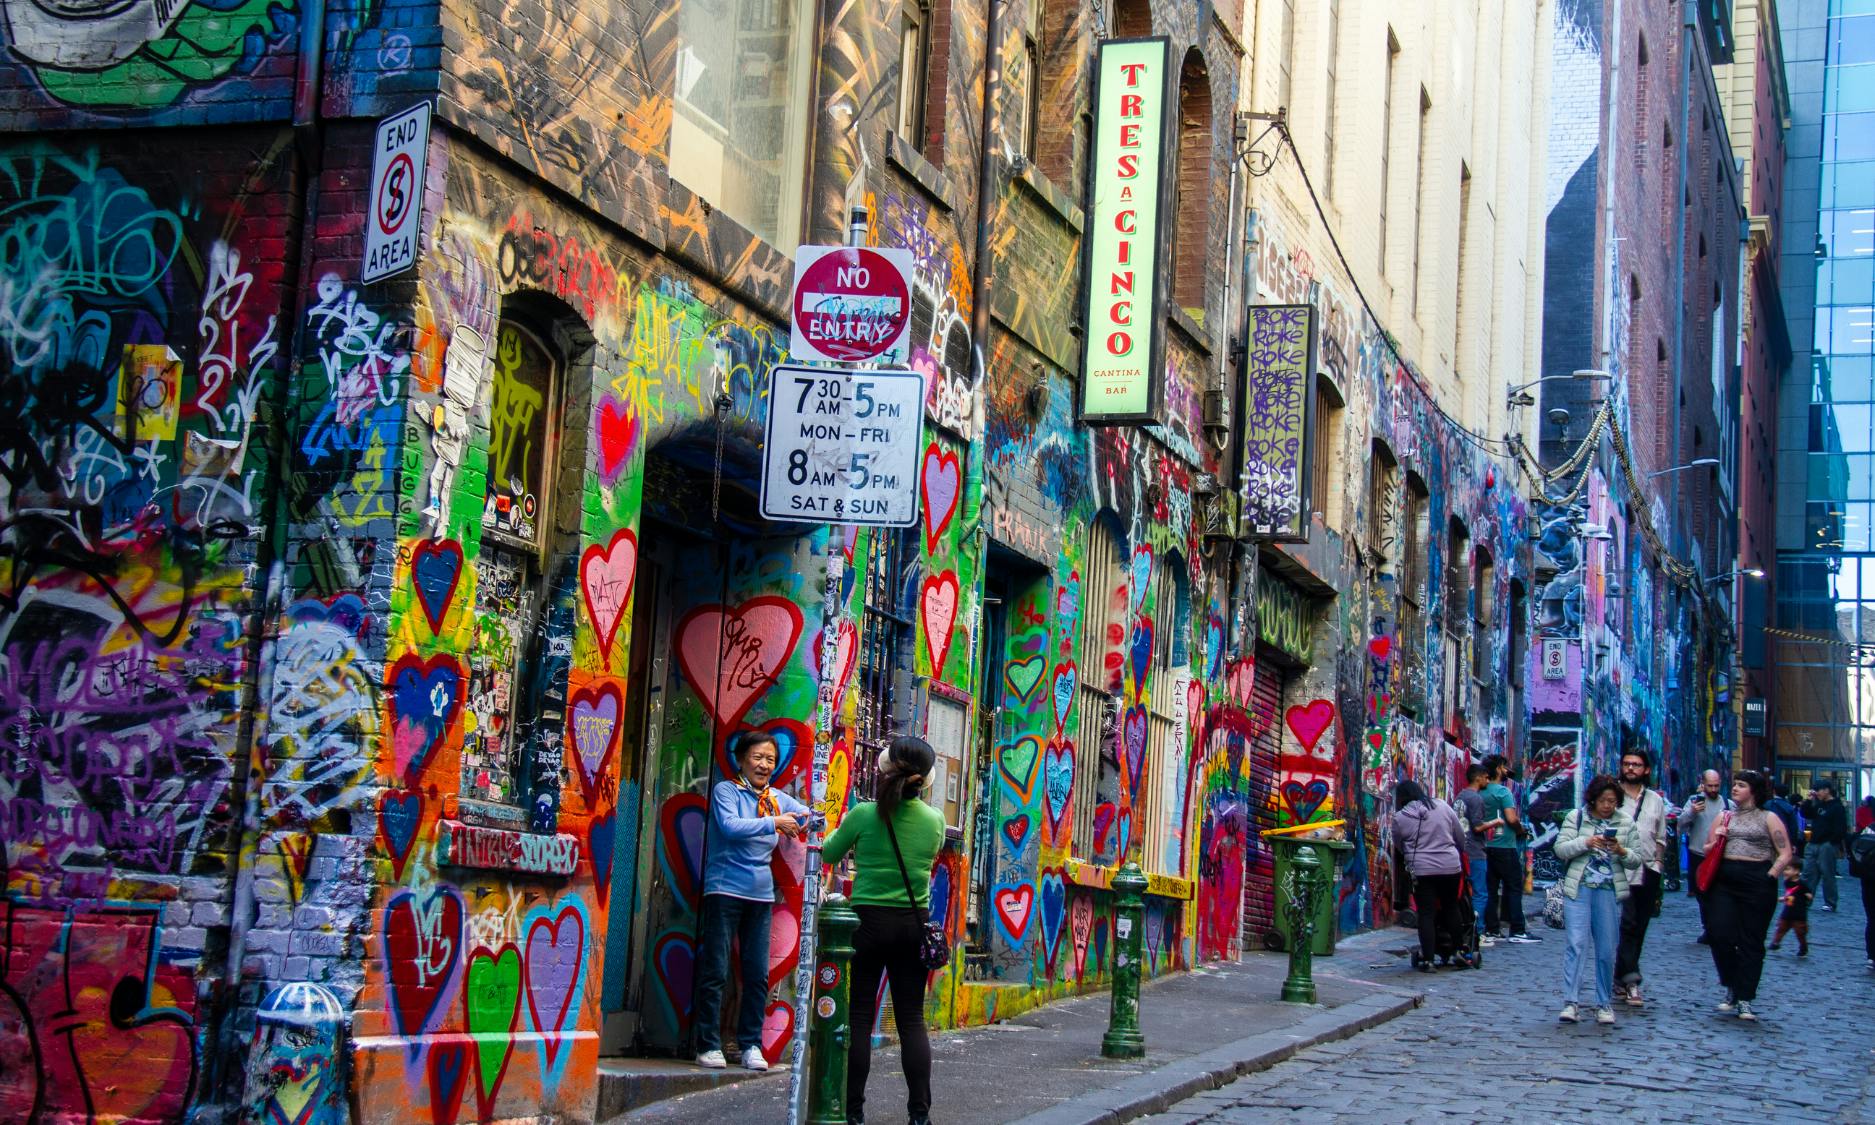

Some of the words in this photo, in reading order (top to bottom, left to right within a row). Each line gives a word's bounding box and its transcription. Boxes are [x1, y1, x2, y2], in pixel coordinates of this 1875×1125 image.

[1117, 63, 1147, 180] TRES
[386, 118, 418, 152] END
[367, 235, 411, 273] AREA
[836, 266, 870, 289] NO
[1106, 209, 1137, 358] CINCO
[809, 319, 889, 344] ENTRY
[1093, 369, 1141, 378] CANTINA
[794, 377, 815, 414] 7
[817, 379, 841, 399] 30
[1105, 386, 1128, 395] BAR
[815, 400, 841, 416] AM
[854, 382, 875, 419] 5
[877, 402, 900, 418] PM
[800, 423, 841, 440] MON
[860, 427, 889, 443] FRI
[787, 448, 808, 486] 8
[810, 471, 836, 487] AM
[849, 453, 870, 490] 5
[872, 475, 896, 490] PM
[790, 495, 829, 512] SAT
[833, 498, 845, 513] &
[850, 499, 889, 515] SUN
[1548, 642, 1562, 651] END
[1546, 667, 1564, 675] AREA
